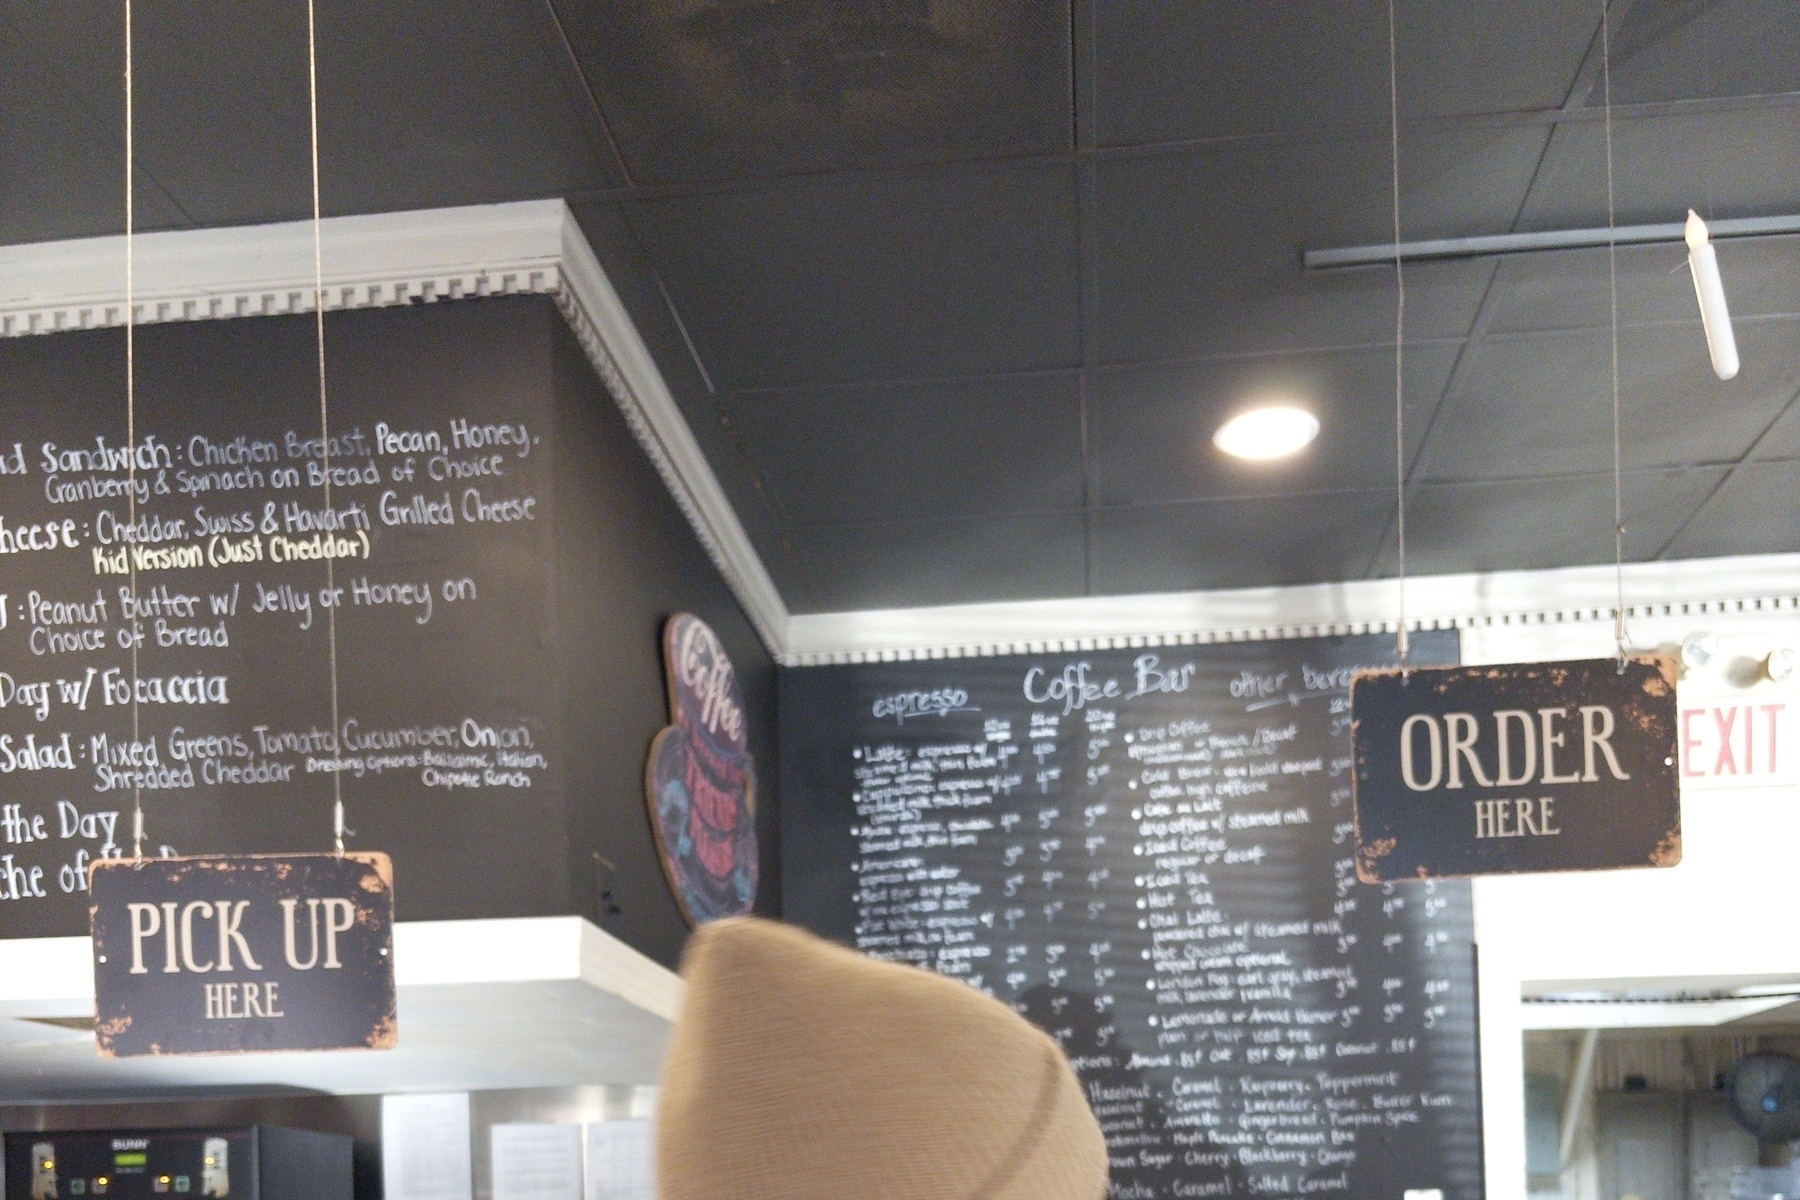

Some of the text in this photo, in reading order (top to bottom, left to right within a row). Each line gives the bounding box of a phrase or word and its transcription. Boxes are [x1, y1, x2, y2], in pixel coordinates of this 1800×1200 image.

[188, 434, 279, 467] Chicken
[374, 421, 449, 456] Pecan,
[45, 453, 504, 504] Cranberry & Spinach on Bread of Choice
[193, 504, 255, 537] Swiss
[259, 501, 279, 535] &
[283, 500, 371, 533] Havarti
[379, 489, 455, 526] Grilled
[461, 487, 536, 523] Cheese
[92, 528, 371, 575] Kid Version (Just Cheddar)
[27, 589, 109, 625] Peanut
[117, 584, 201, 620] Butter
[209, 581, 240, 616] w/
[252, 581, 313, 631] Jelly
[318, 586, 344, 608] or
[350, 575, 433, 625] Honey
[441, 577, 477, 602] on
[29, 618, 229, 655] Choice of Bread
[0, 666, 230, 721] Day w/ Focaccia
[872, 687, 969, 726] espresso
[1023, 652, 1197, 716] Coffee Bar
[90, 732, 161, 768] Mixed
[1399, 704, 1630, 792] ORDER
[1681, 703, 1786, 778] EXIT
[93, 758, 296, 792] Shredded Cheddar
[482, 767, 532, 788] Ranch
[57, 800, 119, 849] Day
[1475, 796, 1560, 839] HERE
[58, 848, 90, 893] of
[126, 897, 355, 975] PICK UP
[204, 981, 285, 1019] HERE
[1184, 1149, 1230, 1169] Cherry
[1172, 1174, 1233, 1198] Caramel
[1247, 1174, 1290, 1195] Salted
[1297, 1170, 1348, 1194] Caramel
